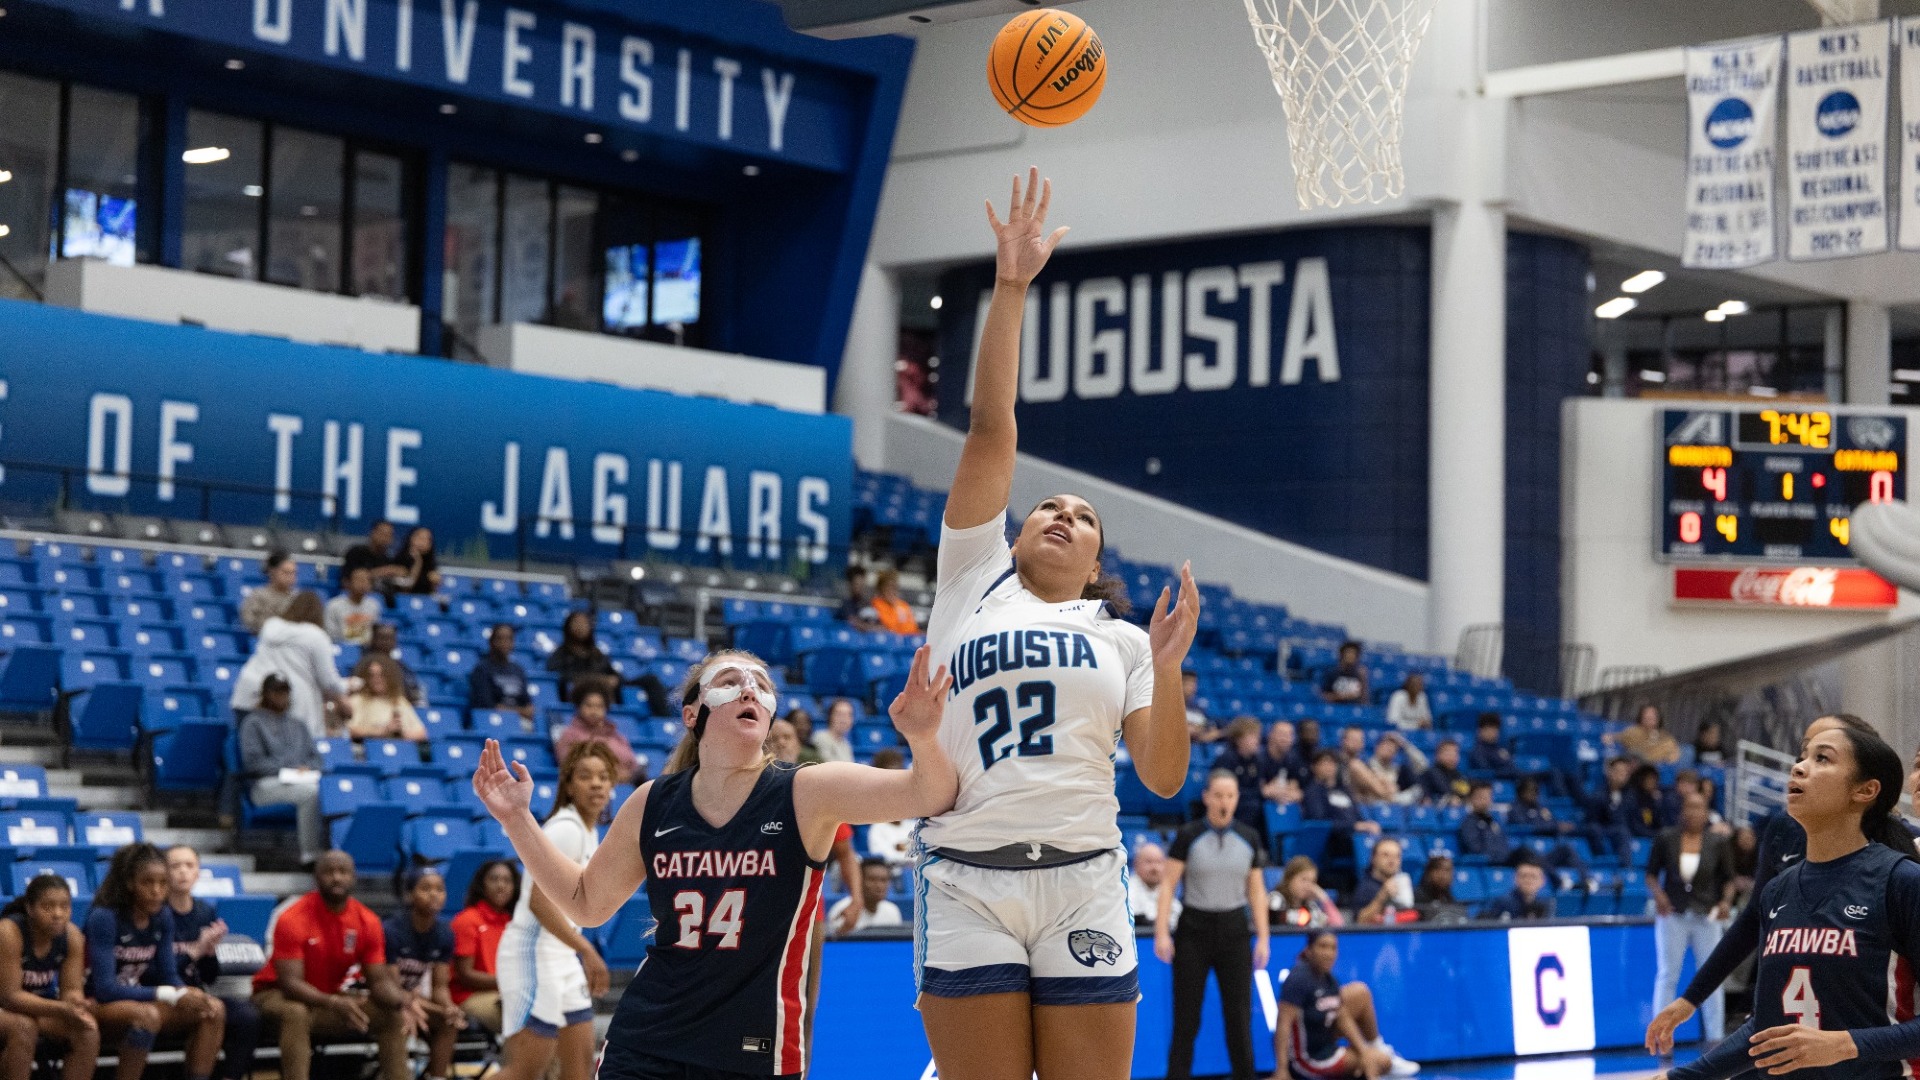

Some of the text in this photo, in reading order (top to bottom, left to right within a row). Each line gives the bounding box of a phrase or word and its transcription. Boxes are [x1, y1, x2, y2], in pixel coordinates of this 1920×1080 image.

[1050, 34, 1103, 92] Wilson
[1796, 57, 1881, 87] BASKETBALL
[1795, 144, 1879, 172] SOUTHEAST
[1802, 174, 1871, 198] REGIONAL
[1760, 409, 1832, 449] 7:42
[87, 393, 198, 501] OF
[267, 413, 423, 524] THE
[481, 441, 830, 564] JAGUARS
[1702, 467, 1727, 502] 4
[1782, 472, 1794, 500] 1
[1679, 511, 1702, 544] 0
[1716, 514, 1738, 543] 4
[1830, 517, 1850, 546] 4
[973, 680, 1056, 771] 22
[762, 821, 783, 831] SAC
[653, 850, 777, 879] CATAWBA
[672, 888, 748, 949] 24
[1848, 904, 1868, 916] SAC
[1534, 952, 1568, 1027] C
[1782, 966, 1821, 1031] 4
